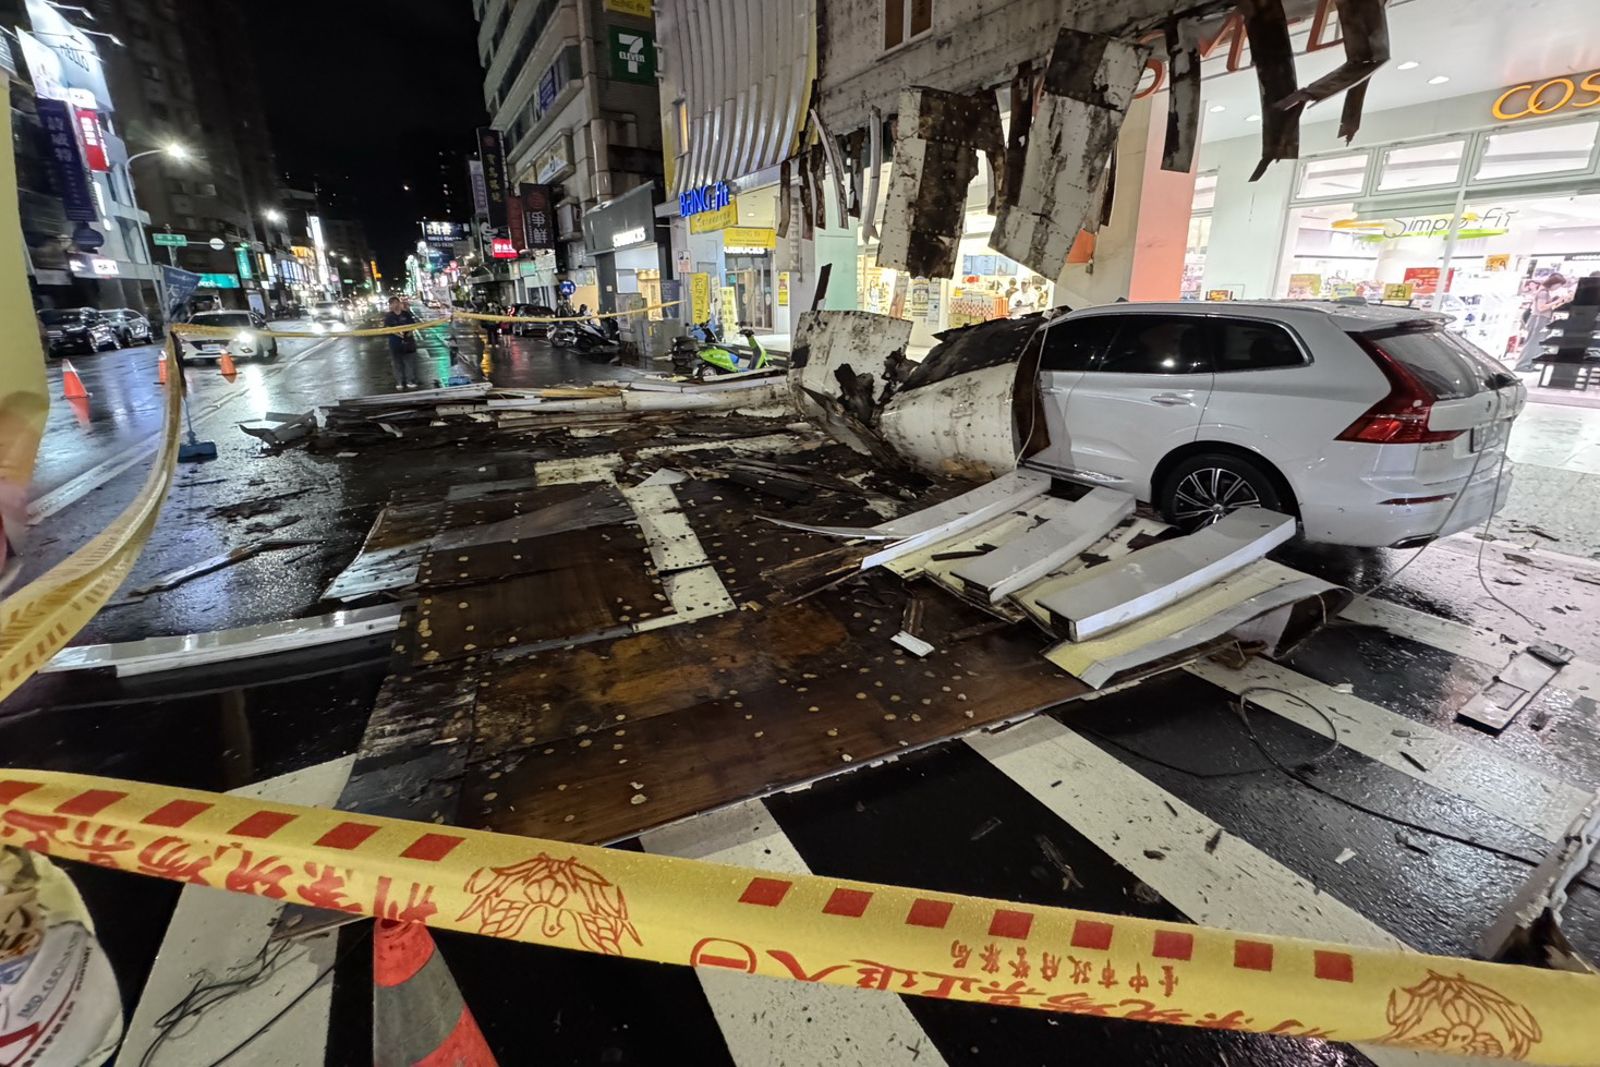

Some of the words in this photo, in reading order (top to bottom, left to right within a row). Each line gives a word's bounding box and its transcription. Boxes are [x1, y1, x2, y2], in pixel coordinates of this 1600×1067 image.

[618, 33, 644, 73] 7
[1492, 71, 1600, 120] COS
[678, 185, 711, 218] BEING
[712, 180, 731, 211] fit
